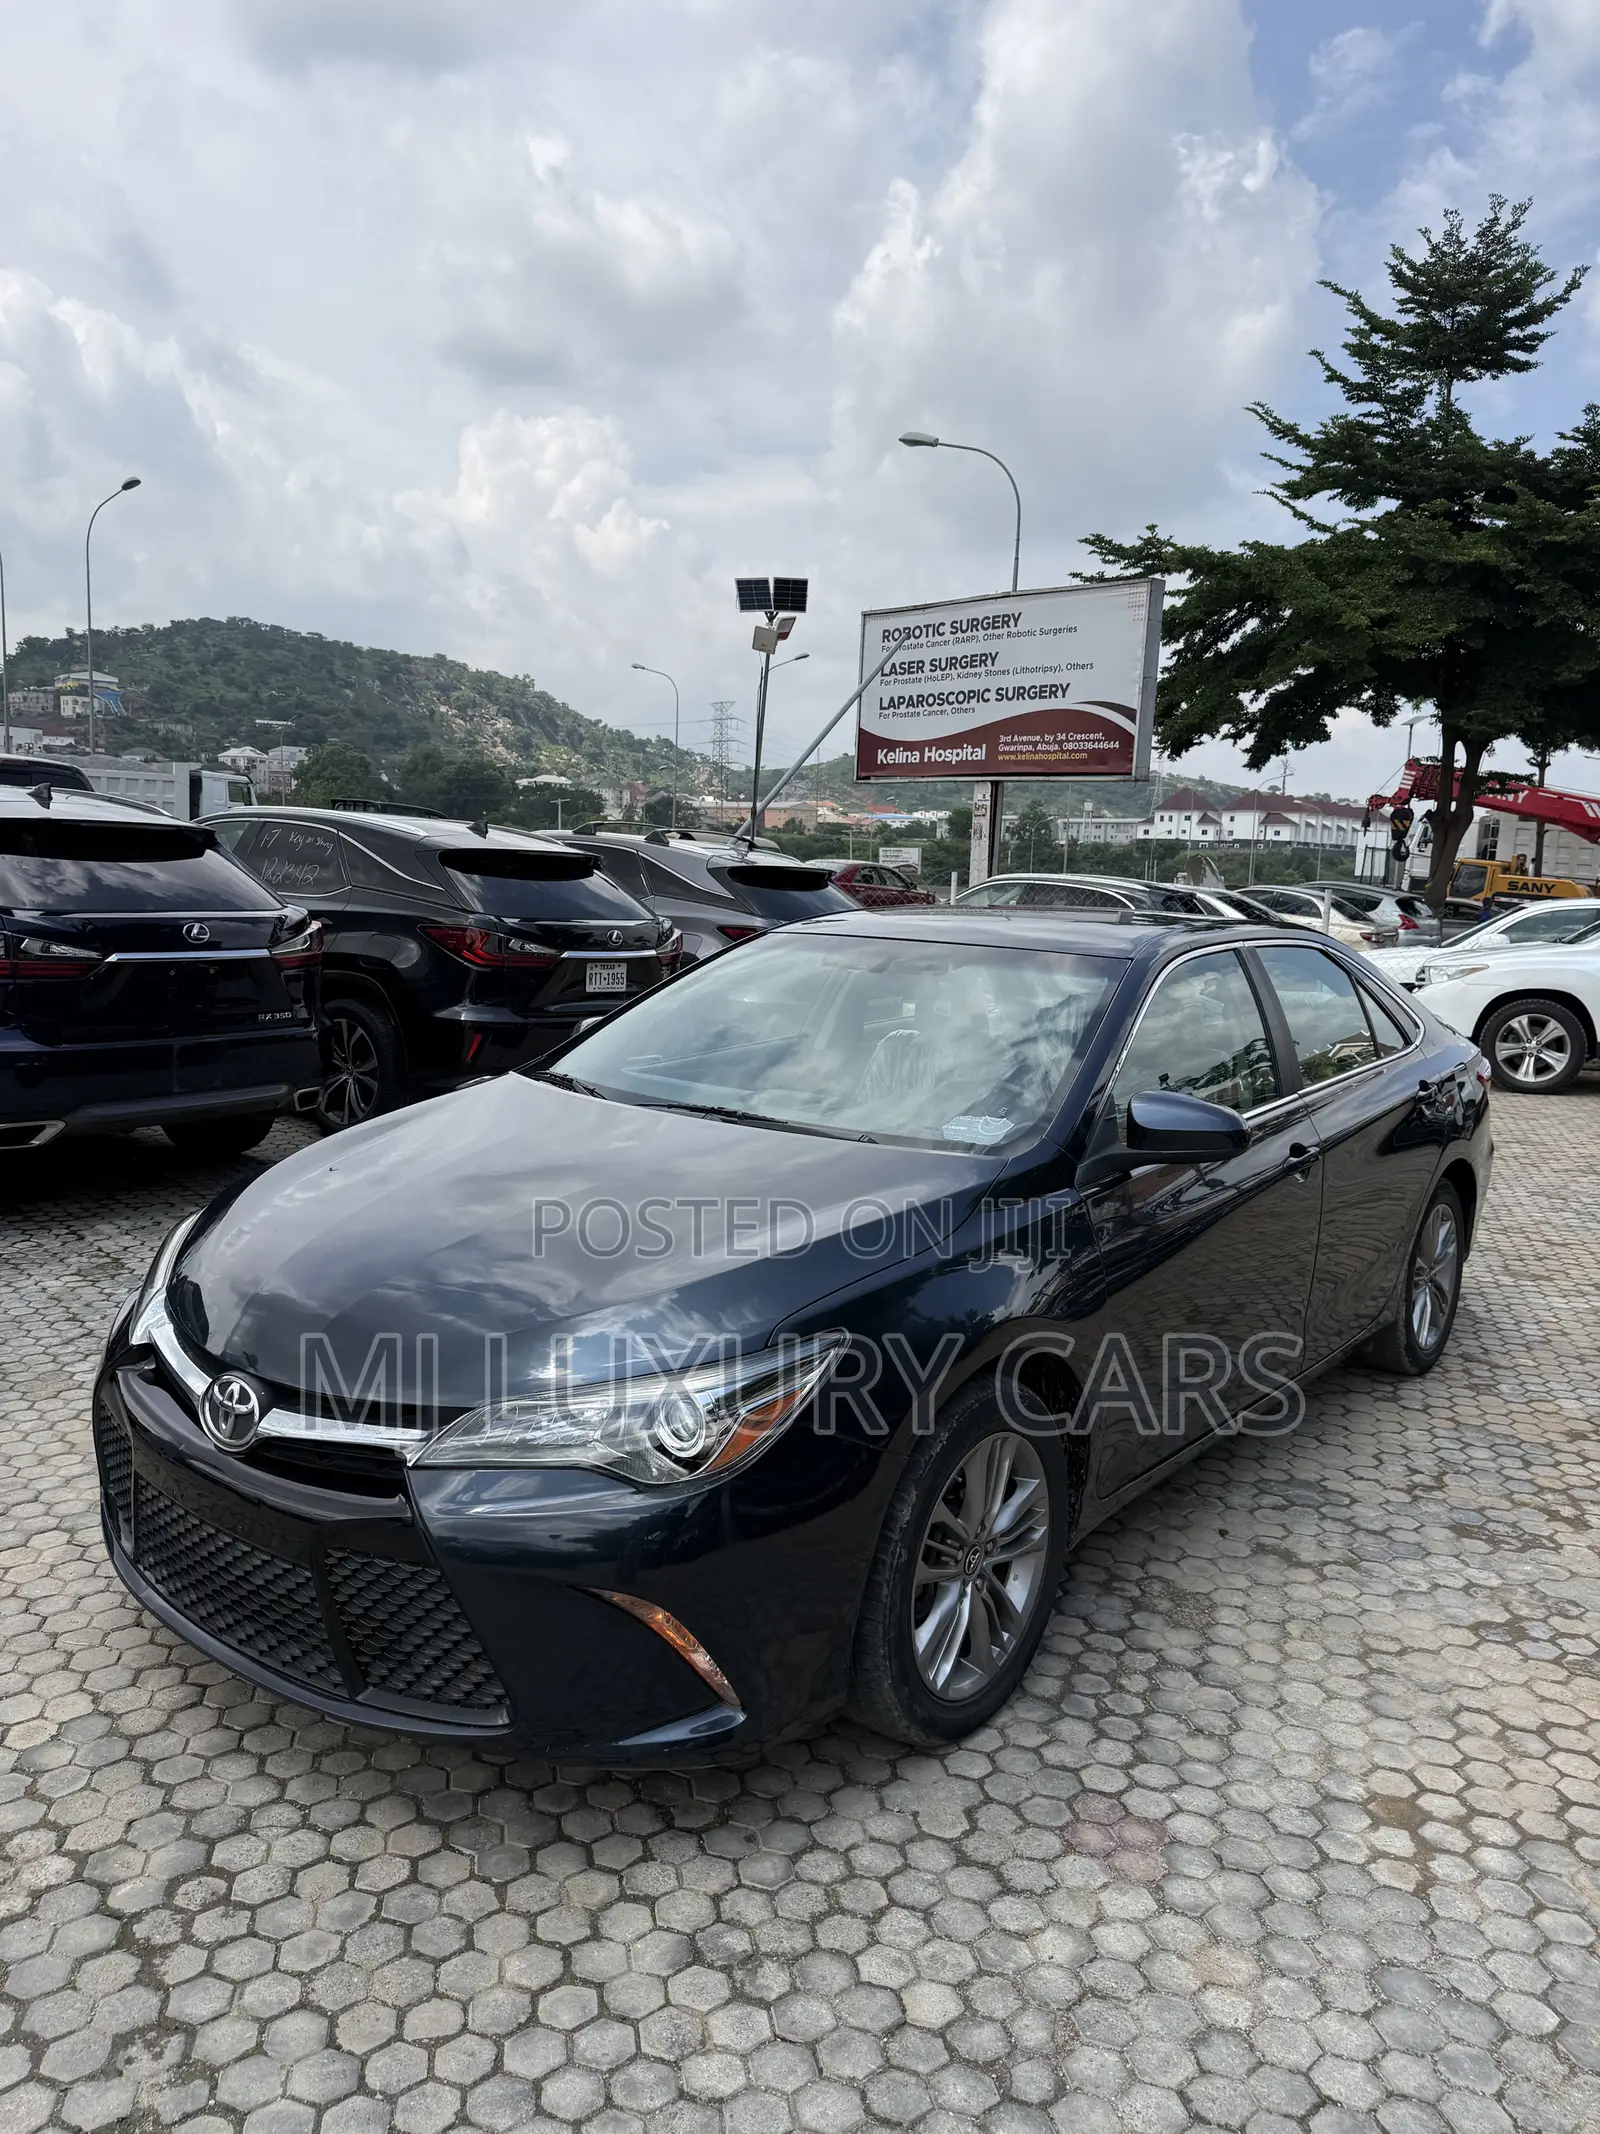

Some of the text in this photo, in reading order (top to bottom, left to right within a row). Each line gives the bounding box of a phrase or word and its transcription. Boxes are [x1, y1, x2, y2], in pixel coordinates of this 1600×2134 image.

[881, 612, 1022, 643] ROBOTIC SURGERY
[898, 641, 924, 652] rostate
[925, 639, 951, 648] Cancer
[982, 632, 1004, 641] Other
[1006, 628, 1037, 639] Robotic
[1039, 625, 1078, 637] Surgeries
[880, 651, 1000, 677] LASER SURGERY
[880, 678, 891, 686] For
[893, 676, 923, 686] Prostate
[956, 669, 982, 680] Kidney
[984, 668, 1010, 677] Stones
[1065, 662, 1094, 671] Others
[879, 682, 1071, 711] LAPAROSCOPIC SURGERY
[879, 712, 890, 720] For
[891, 710, 921, 719] Prostate
[951, 706, 976, 715] Others
[999, 732, 1105, 743] 3rd Avenue, by 34 Crescent,
[877, 743, 987, 765] Kelina Hospital
[998, 752, 1088, 762] www.kelinahospital.com
[1507, 880, 1556, 894] SANY
[273, 1012, 292, 1020] 350
